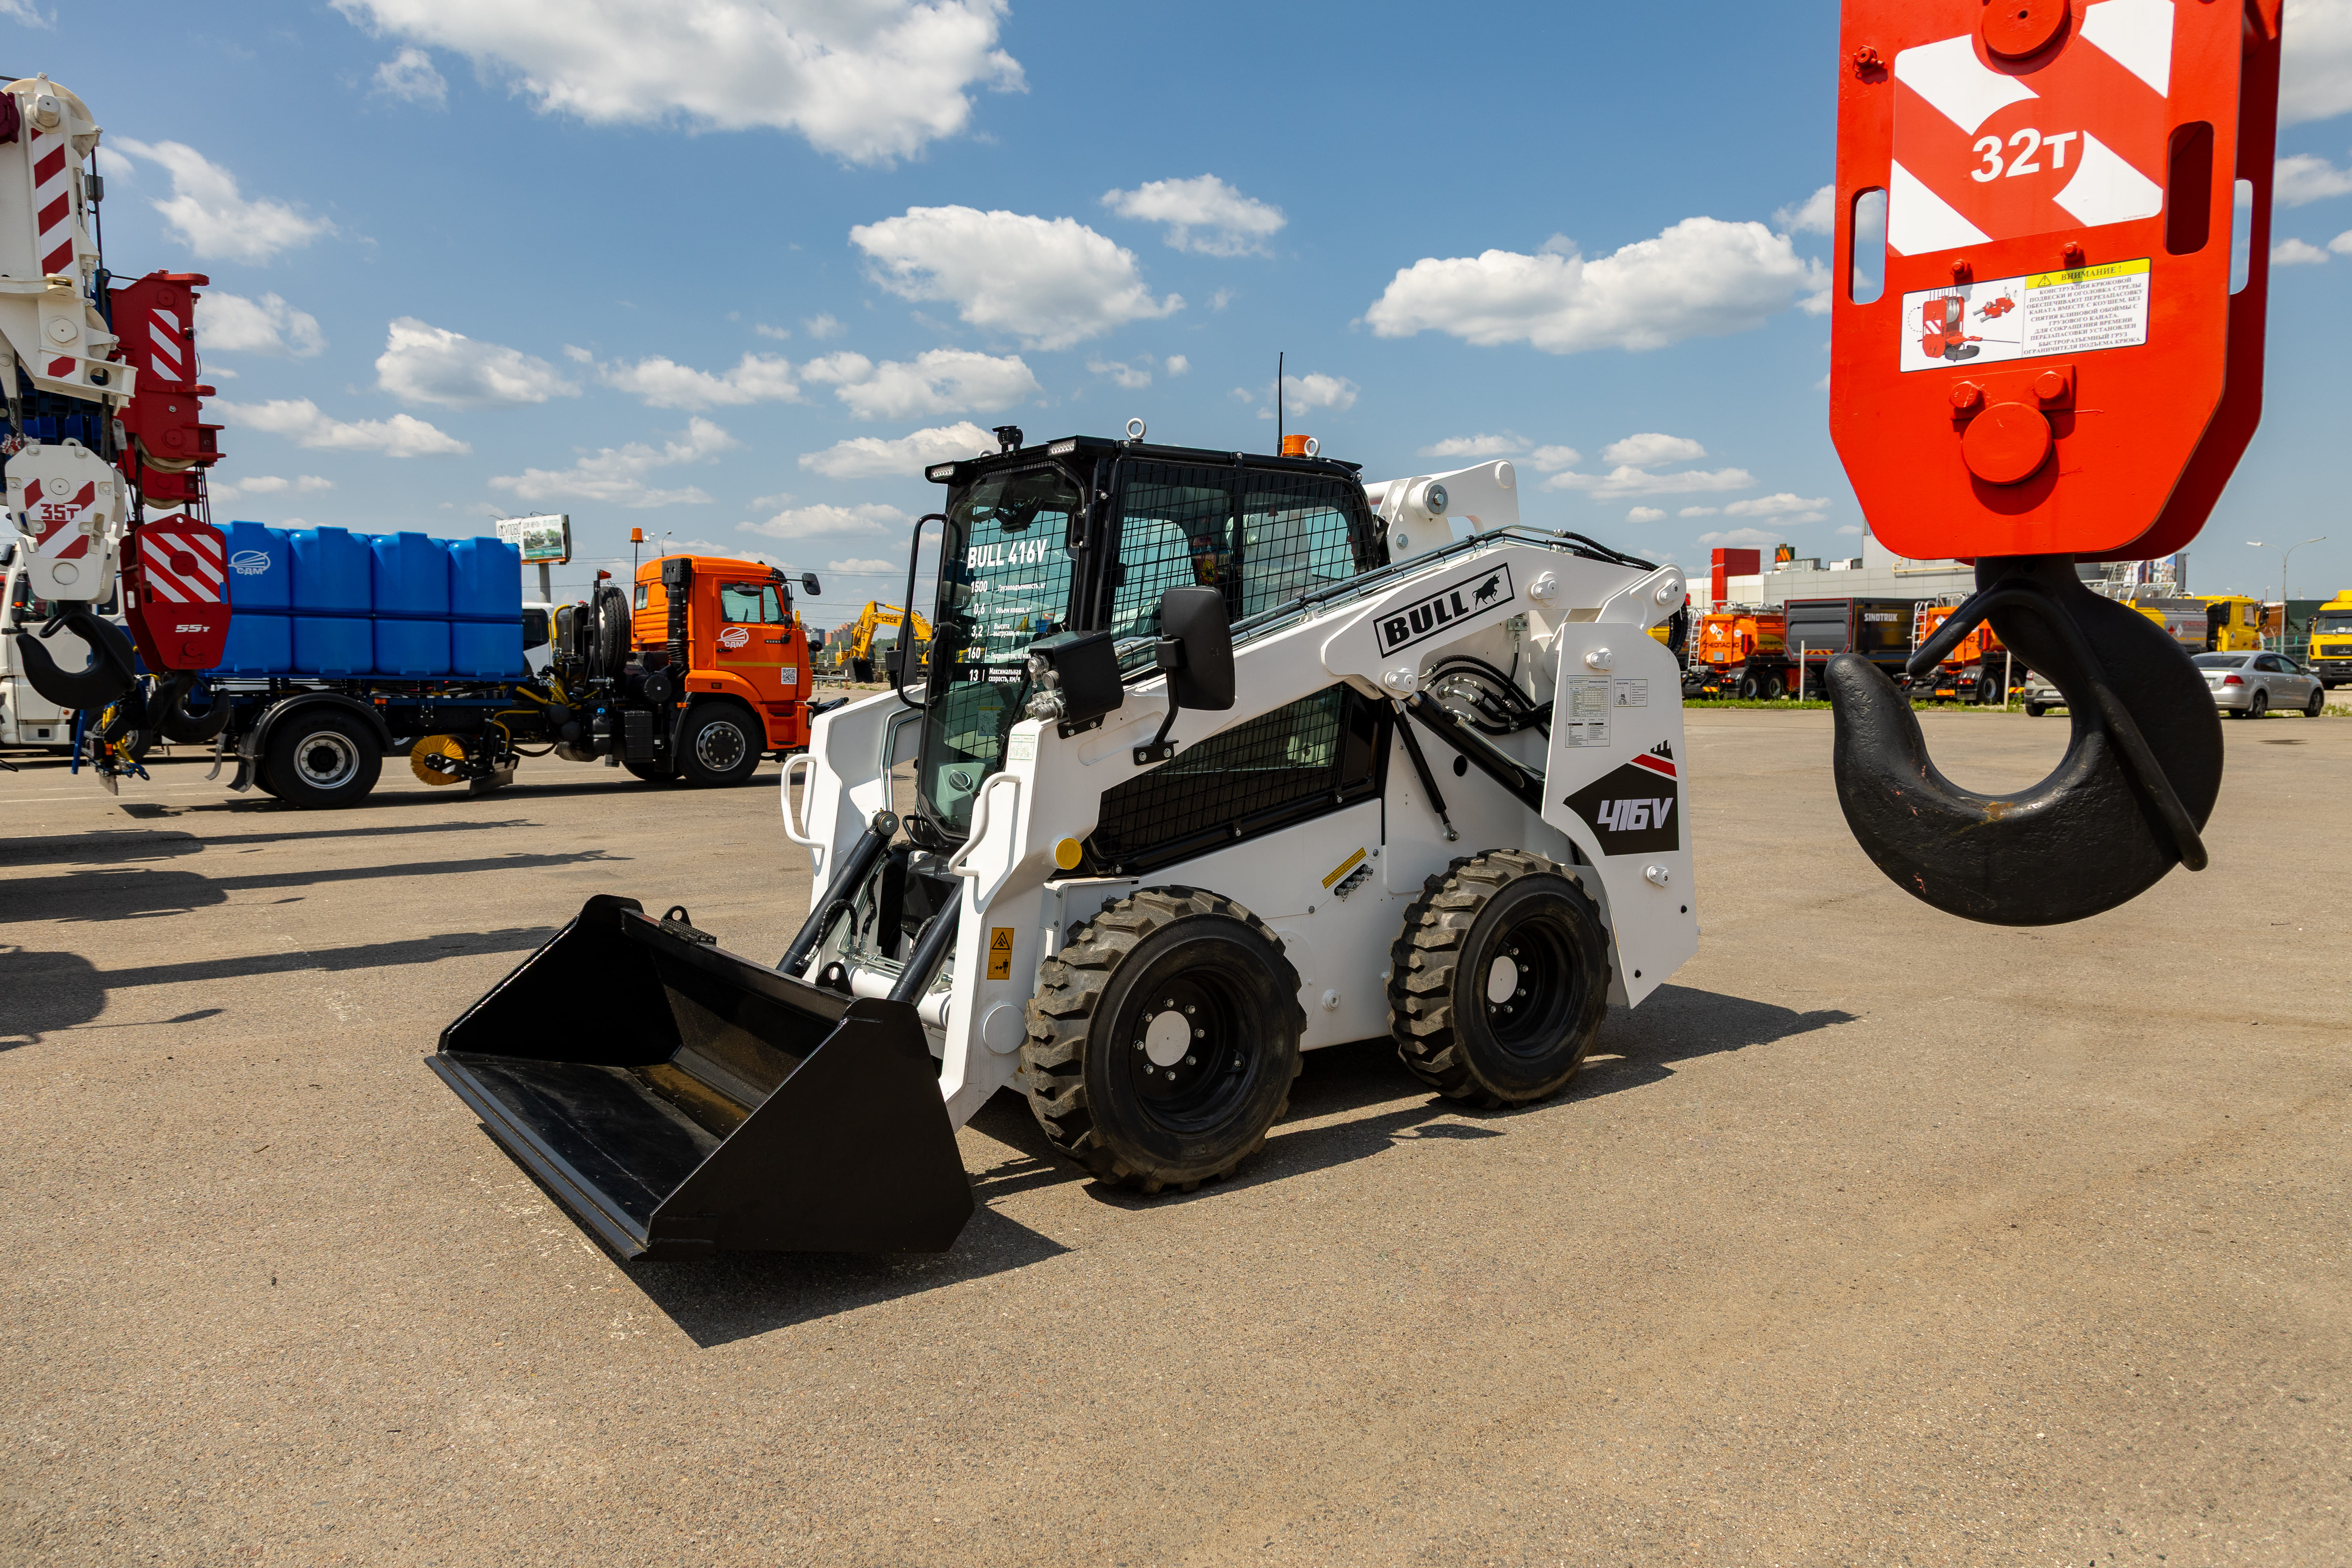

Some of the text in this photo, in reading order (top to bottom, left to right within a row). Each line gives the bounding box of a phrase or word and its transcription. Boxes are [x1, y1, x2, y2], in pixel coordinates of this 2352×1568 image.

[2061, 266, 2116, 280] ВНИМАНИЕ
[2040, 277, 2131, 295] КОНСТРУКЦИЯ КРЮКОВОЙ
[2027, 290, 2143, 309] ОБЕСПЕЧИВАЮТ ПЕРЕЗАПАСОВКУ
[2030, 294, 2065, 302] ПОДВЕСКИ
[2074, 288, 2111, 296] ОГОЛОВКА
[2060, 308, 2098, 318] КЛИНОВОЙ
[2100, 304, 2131, 313] ОБОЙМЫ
[2049, 317, 2088, 326] ГРУЗОВОГО
[2050, 322, 2098, 332] СОКРАЩЕНИЯ
[2031, 324, 2136, 341] ПЕРЕЗАПАСОВКИ УСТАНОВЛЕН
[2039, 334, 2109, 347] БЫСТРОРАЗЪЕМНЫЙ
[2024, 345, 2077, 355] ОГРАНИЧИТЕЛЯ
[967, 539, 1047, 568] BULL 416V
[971, 580, 988, 593] 1500
[998, 583, 1040, 593] Грузоподъемность,
[973, 603, 985, 616] 0,6
[1383, 591, 1469, 647] BULL
[1864, 613, 1897, 622] SINOTRUK
[971, 625, 983, 639] 3,2
[967, 647, 981, 659] 160
[969, 670, 979, 682] 13
[1598, 798, 1673, 831] 416V
